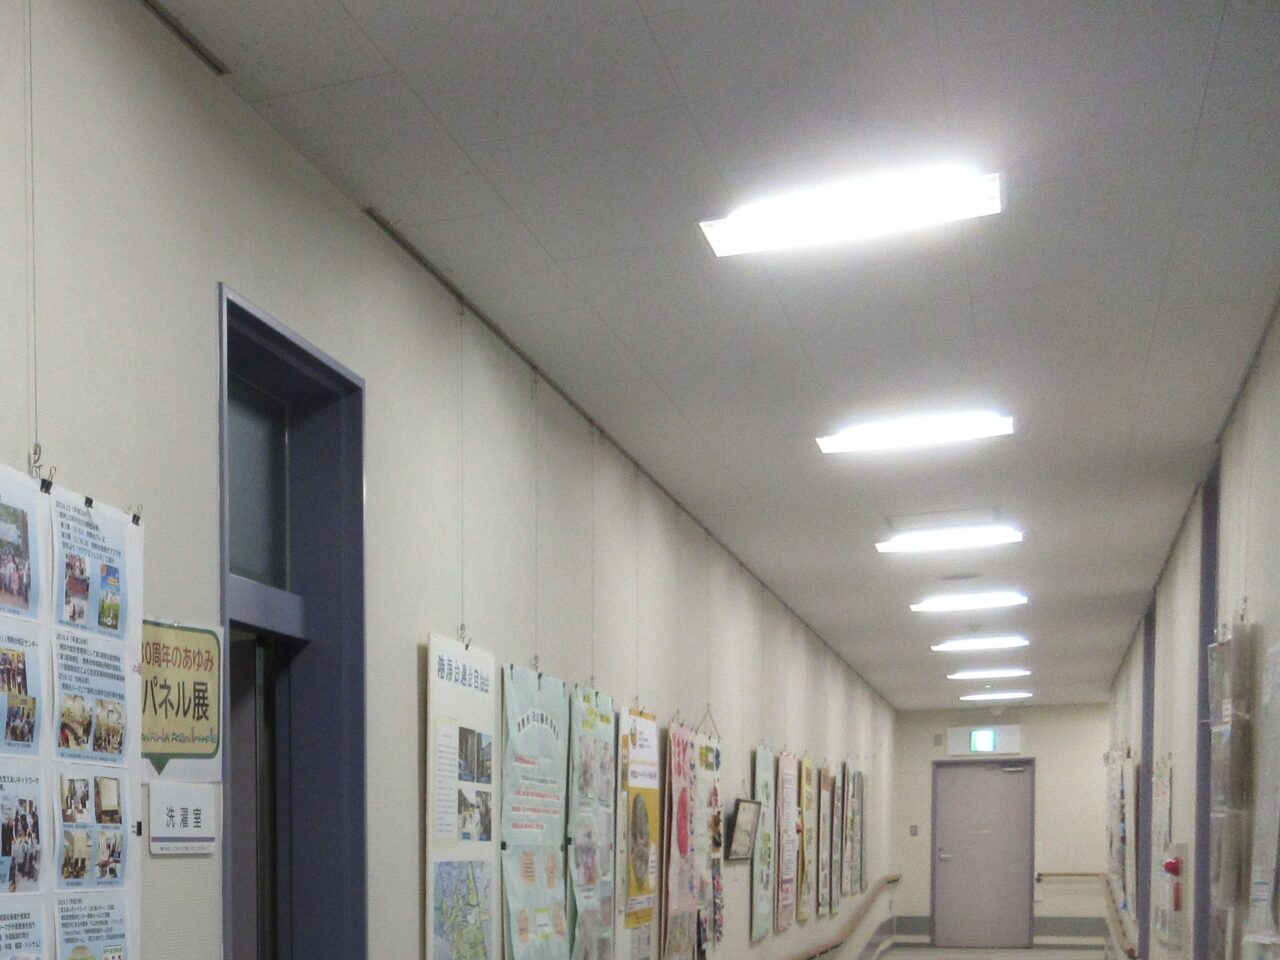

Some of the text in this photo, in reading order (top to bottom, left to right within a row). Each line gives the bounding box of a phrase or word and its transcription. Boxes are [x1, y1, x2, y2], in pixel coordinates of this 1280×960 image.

[142, 676, 210, 722] パネル展
[166, 806, 202, 829] 洗濯室
